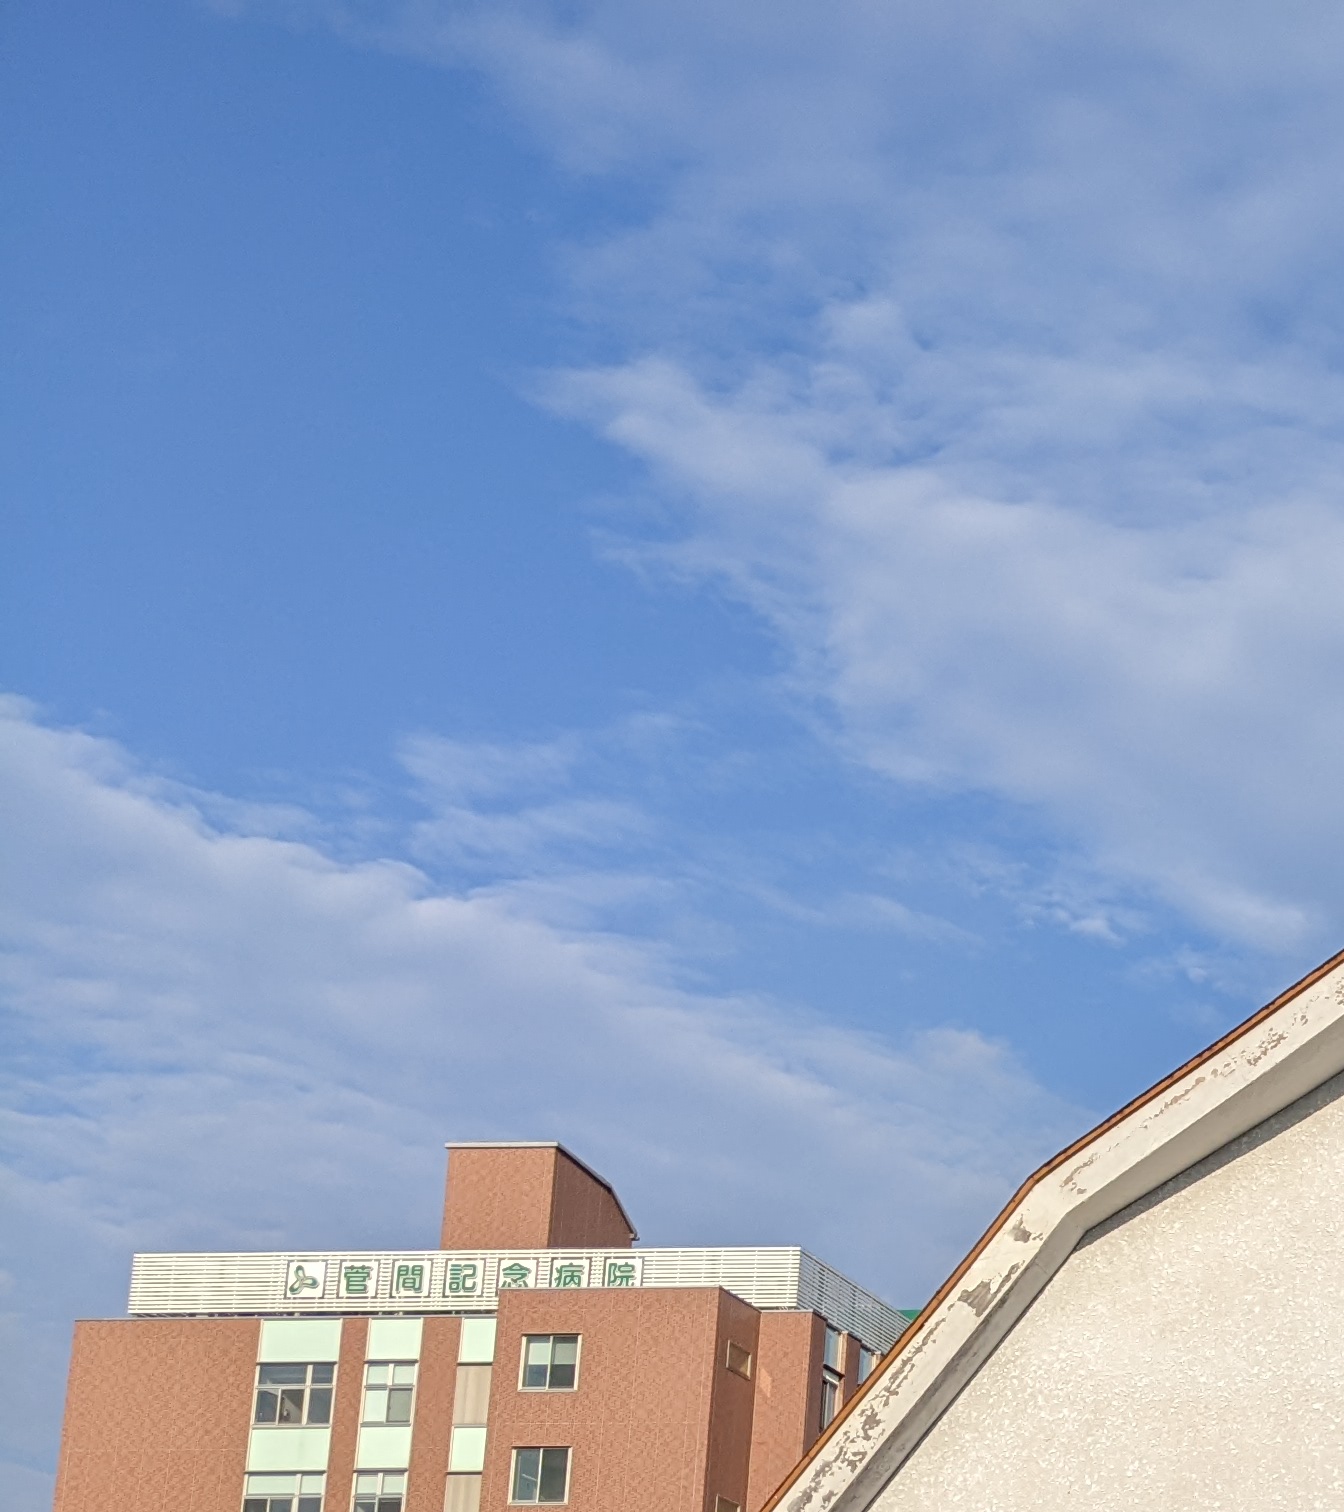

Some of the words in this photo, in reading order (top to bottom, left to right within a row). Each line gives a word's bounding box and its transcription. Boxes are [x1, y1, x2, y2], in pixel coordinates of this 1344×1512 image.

[343, 1261, 637, 1295] 菅間記念病院
